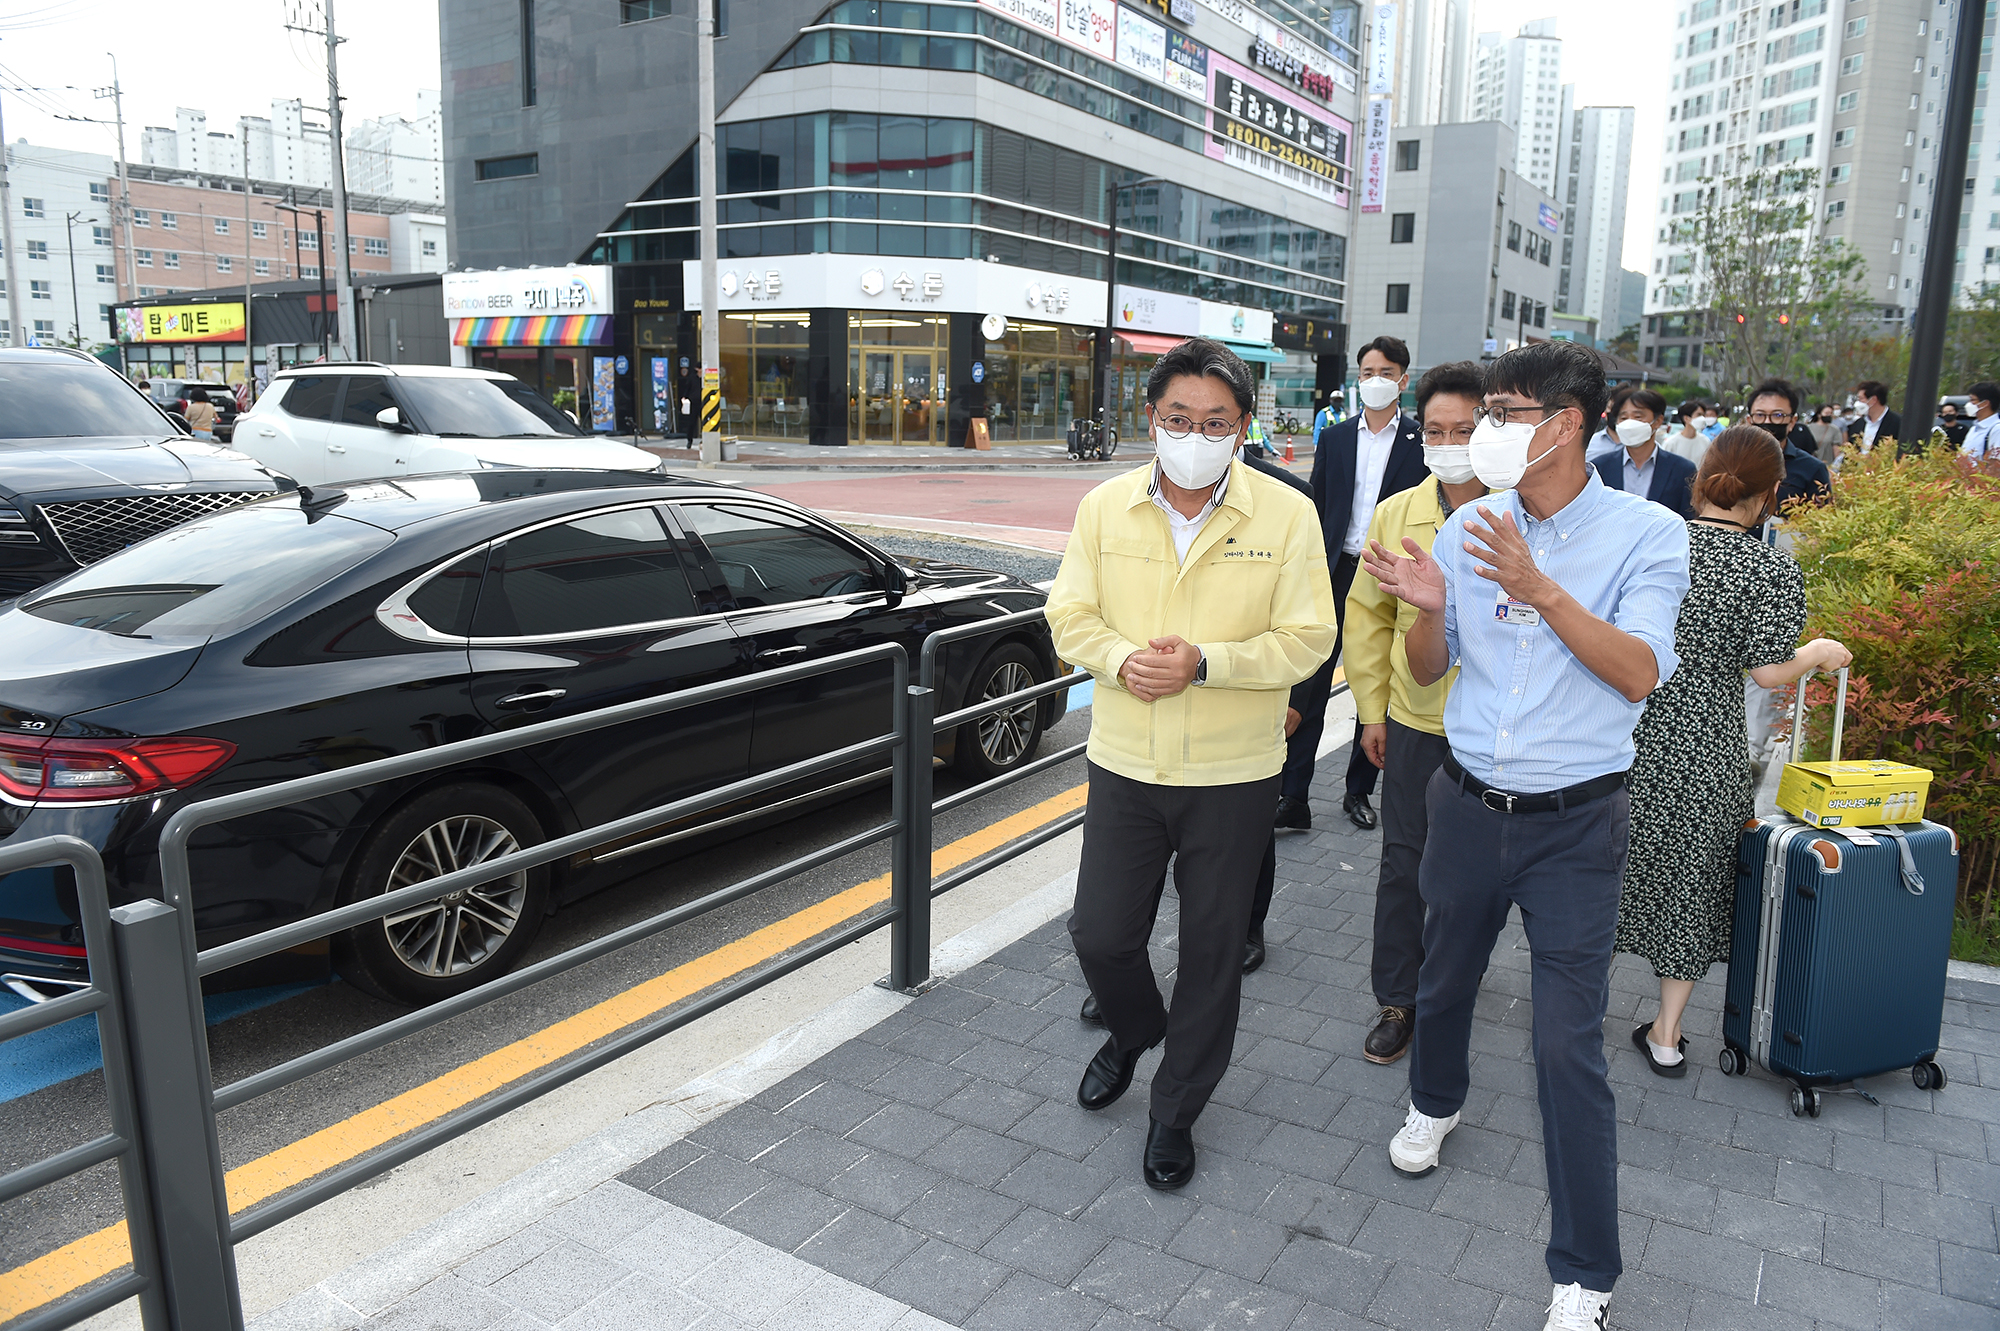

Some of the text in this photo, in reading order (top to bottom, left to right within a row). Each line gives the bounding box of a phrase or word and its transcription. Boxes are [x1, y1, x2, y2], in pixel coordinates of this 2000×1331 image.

[1171, 48, 1192, 68] FUN
[1172, 34, 1206, 60] MATH
[743, 270, 781, 295] 수돈
[893, 271, 944, 297] 수돈
[448, 295, 513, 310] Rainbow BEER
[522, 284, 585, 309] 무지개맥주
[1044, 285, 1070, 309] 수돈
[181, 311, 209, 334] 마트
[1305, 321, 1314, 342] P
